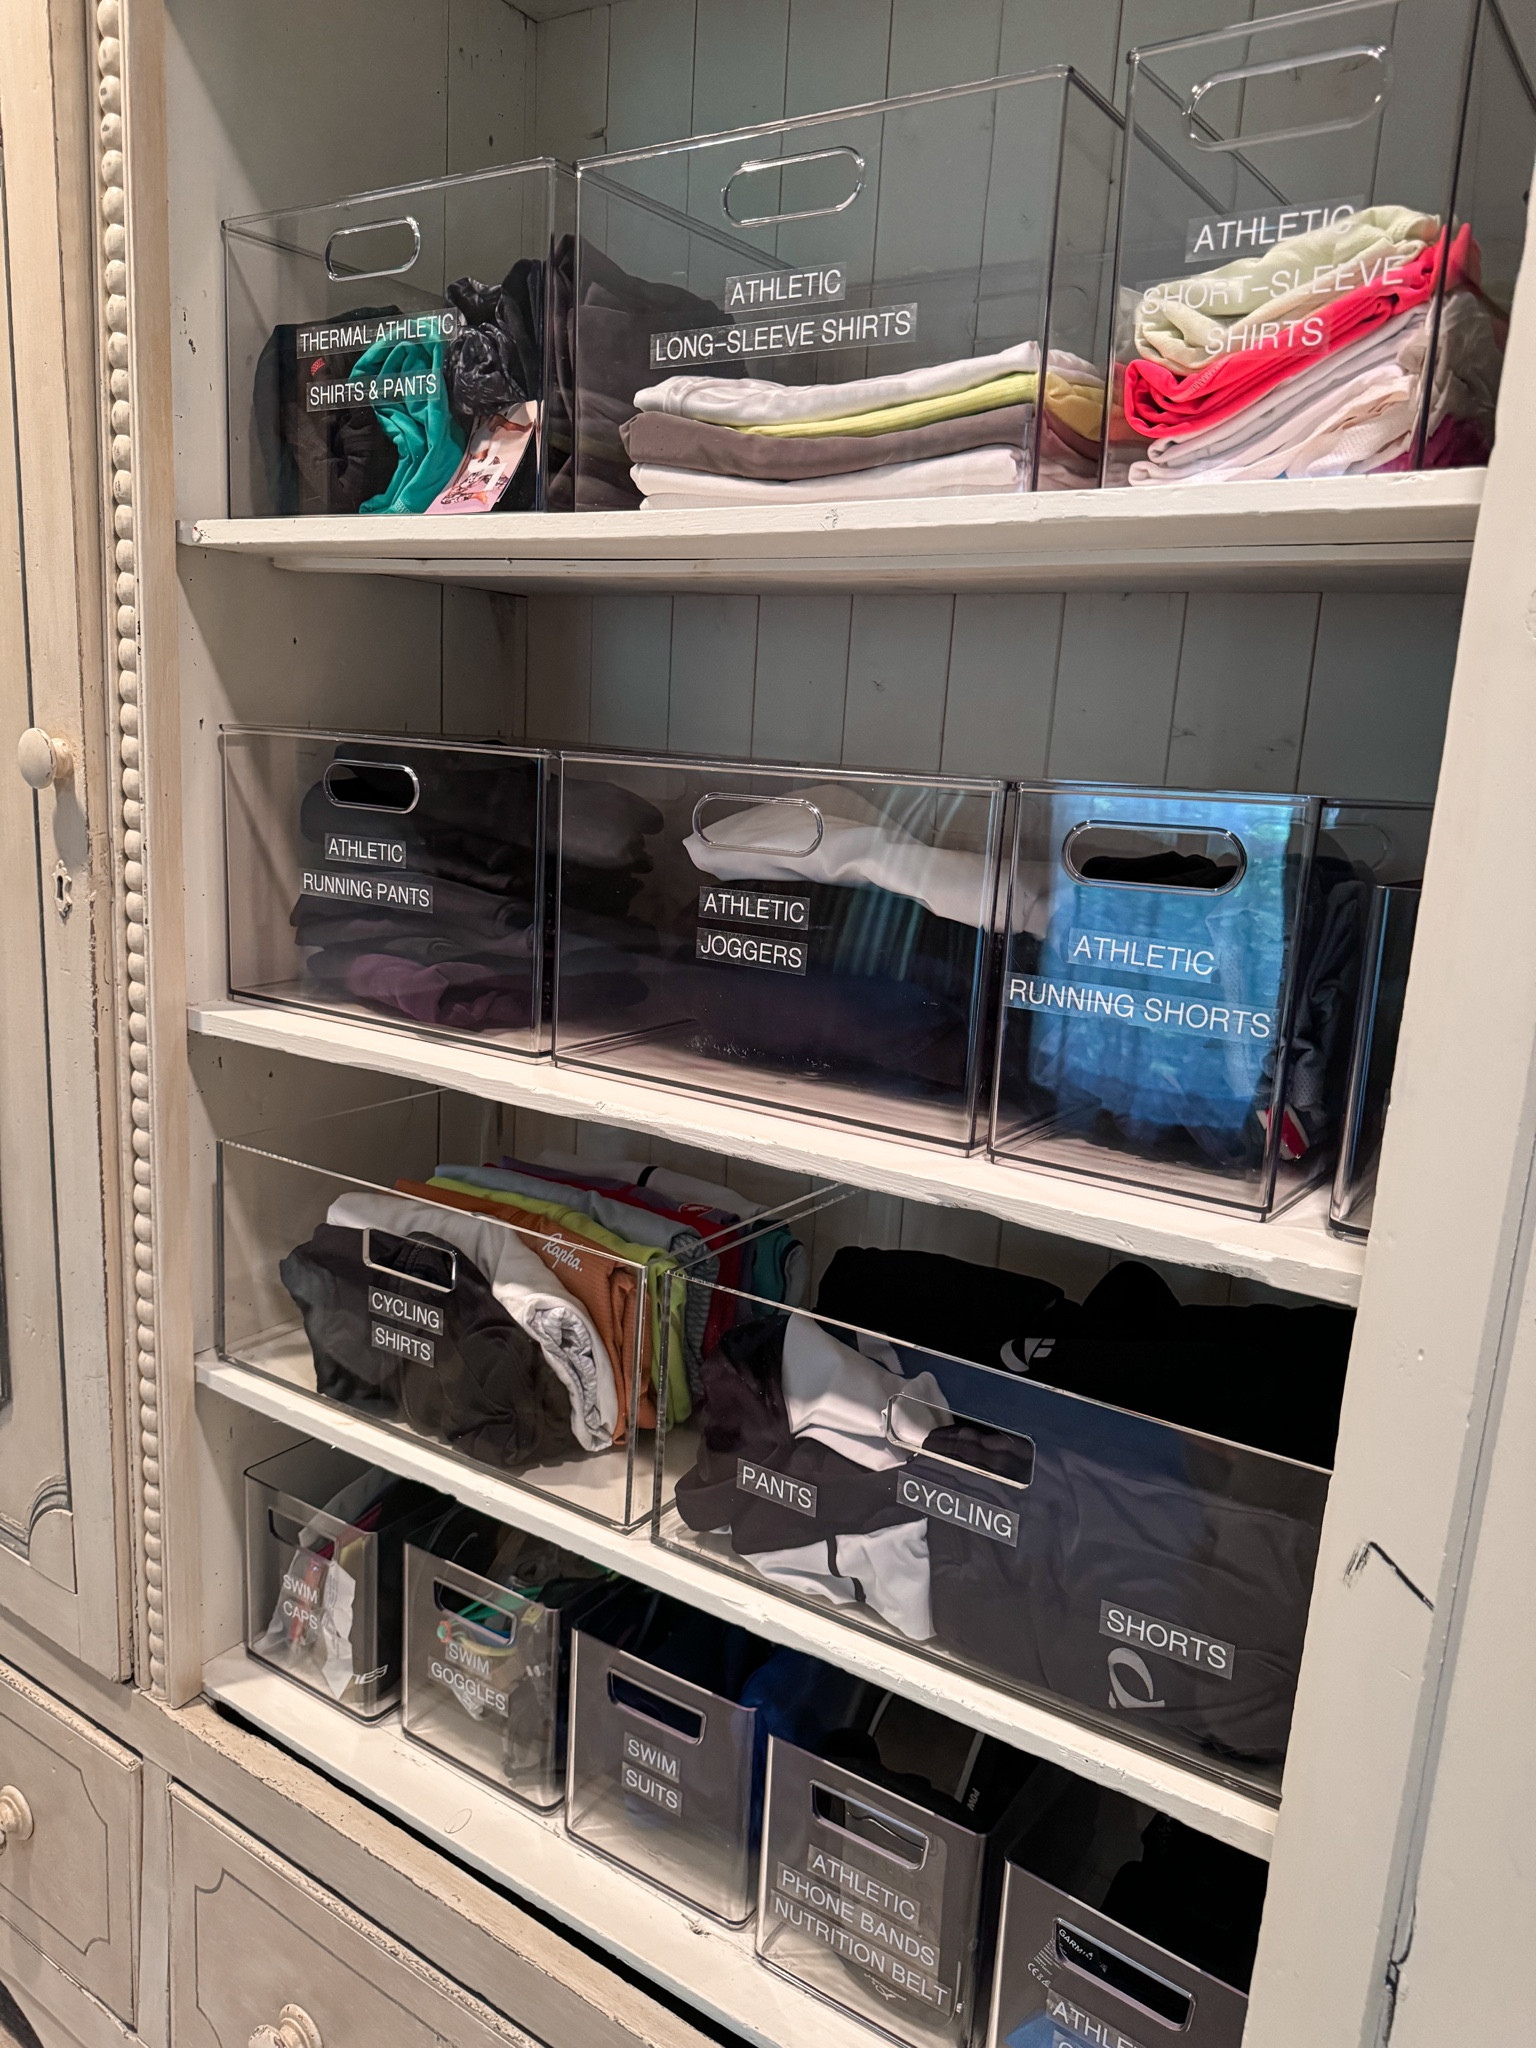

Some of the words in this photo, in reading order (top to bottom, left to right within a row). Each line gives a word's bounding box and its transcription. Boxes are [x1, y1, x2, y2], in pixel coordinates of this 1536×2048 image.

[1193, 205, 1355, 253] ATHLETIC
[729, 269, 842, 306] ATHLETIC
[1141, 256, 1405, 315] SHORT-SLEEVE
[300, 327, 372, 352] THERMAL
[375, 313, 454, 341] ATHLETIC
[655, 321, 815, 362] LONG-SLEEVE
[821, 310, 911, 344] SHIRTS
[1204, 317, 1324, 354] SHIRTS
[309, 381, 364, 406] SHIRTS
[368, 381, 379, 400] &
[383, 373, 437, 397] PANTS
[328, 838, 403, 863] ATHLETIC
[303, 873, 373, 899] RUNNING
[377, 883, 430, 908] PANTS
[703, 892, 805, 924] ATHLETIC
[700, 934, 802, 969] JOGGERS
[1073, 935, 1215, 976] ATHLETIC
[1009, 979, 1135, 1018] RUNNING
[1143, 998, 1271, 1038] SHORTS
[371, 1292, 440, 1329] CYCLING
[374, 1327, 432, 1361] SHIRTS
[742, 1466, 813, 1509] PANTS
[903, 1481, 1013, 1538] CYCLING
[283, 1574, 318, 1604] SWIM
[283, 1600, 318, 1630] CAPS
[449, 1643, 490, 1675] SWIM
[1107, 1610, 1227, 1671] SHORTS
[431, 1663, 506, 1711] GOGGLES
[627, 1738, 677, 1777] SWIM
[625, 1770, 678, 1809] SUITS
[812, 1858, 916, 1921] ATHLETIC
[782, 1869, 854, 1924] PHONE
[860, 1914, 935, 1967] BANDS
[774, 1897, 885, 1974] NUTRITION
[891, 1961, 948, 2006] BELT
[1052, 2001, 1137, 2048] ATHLE
